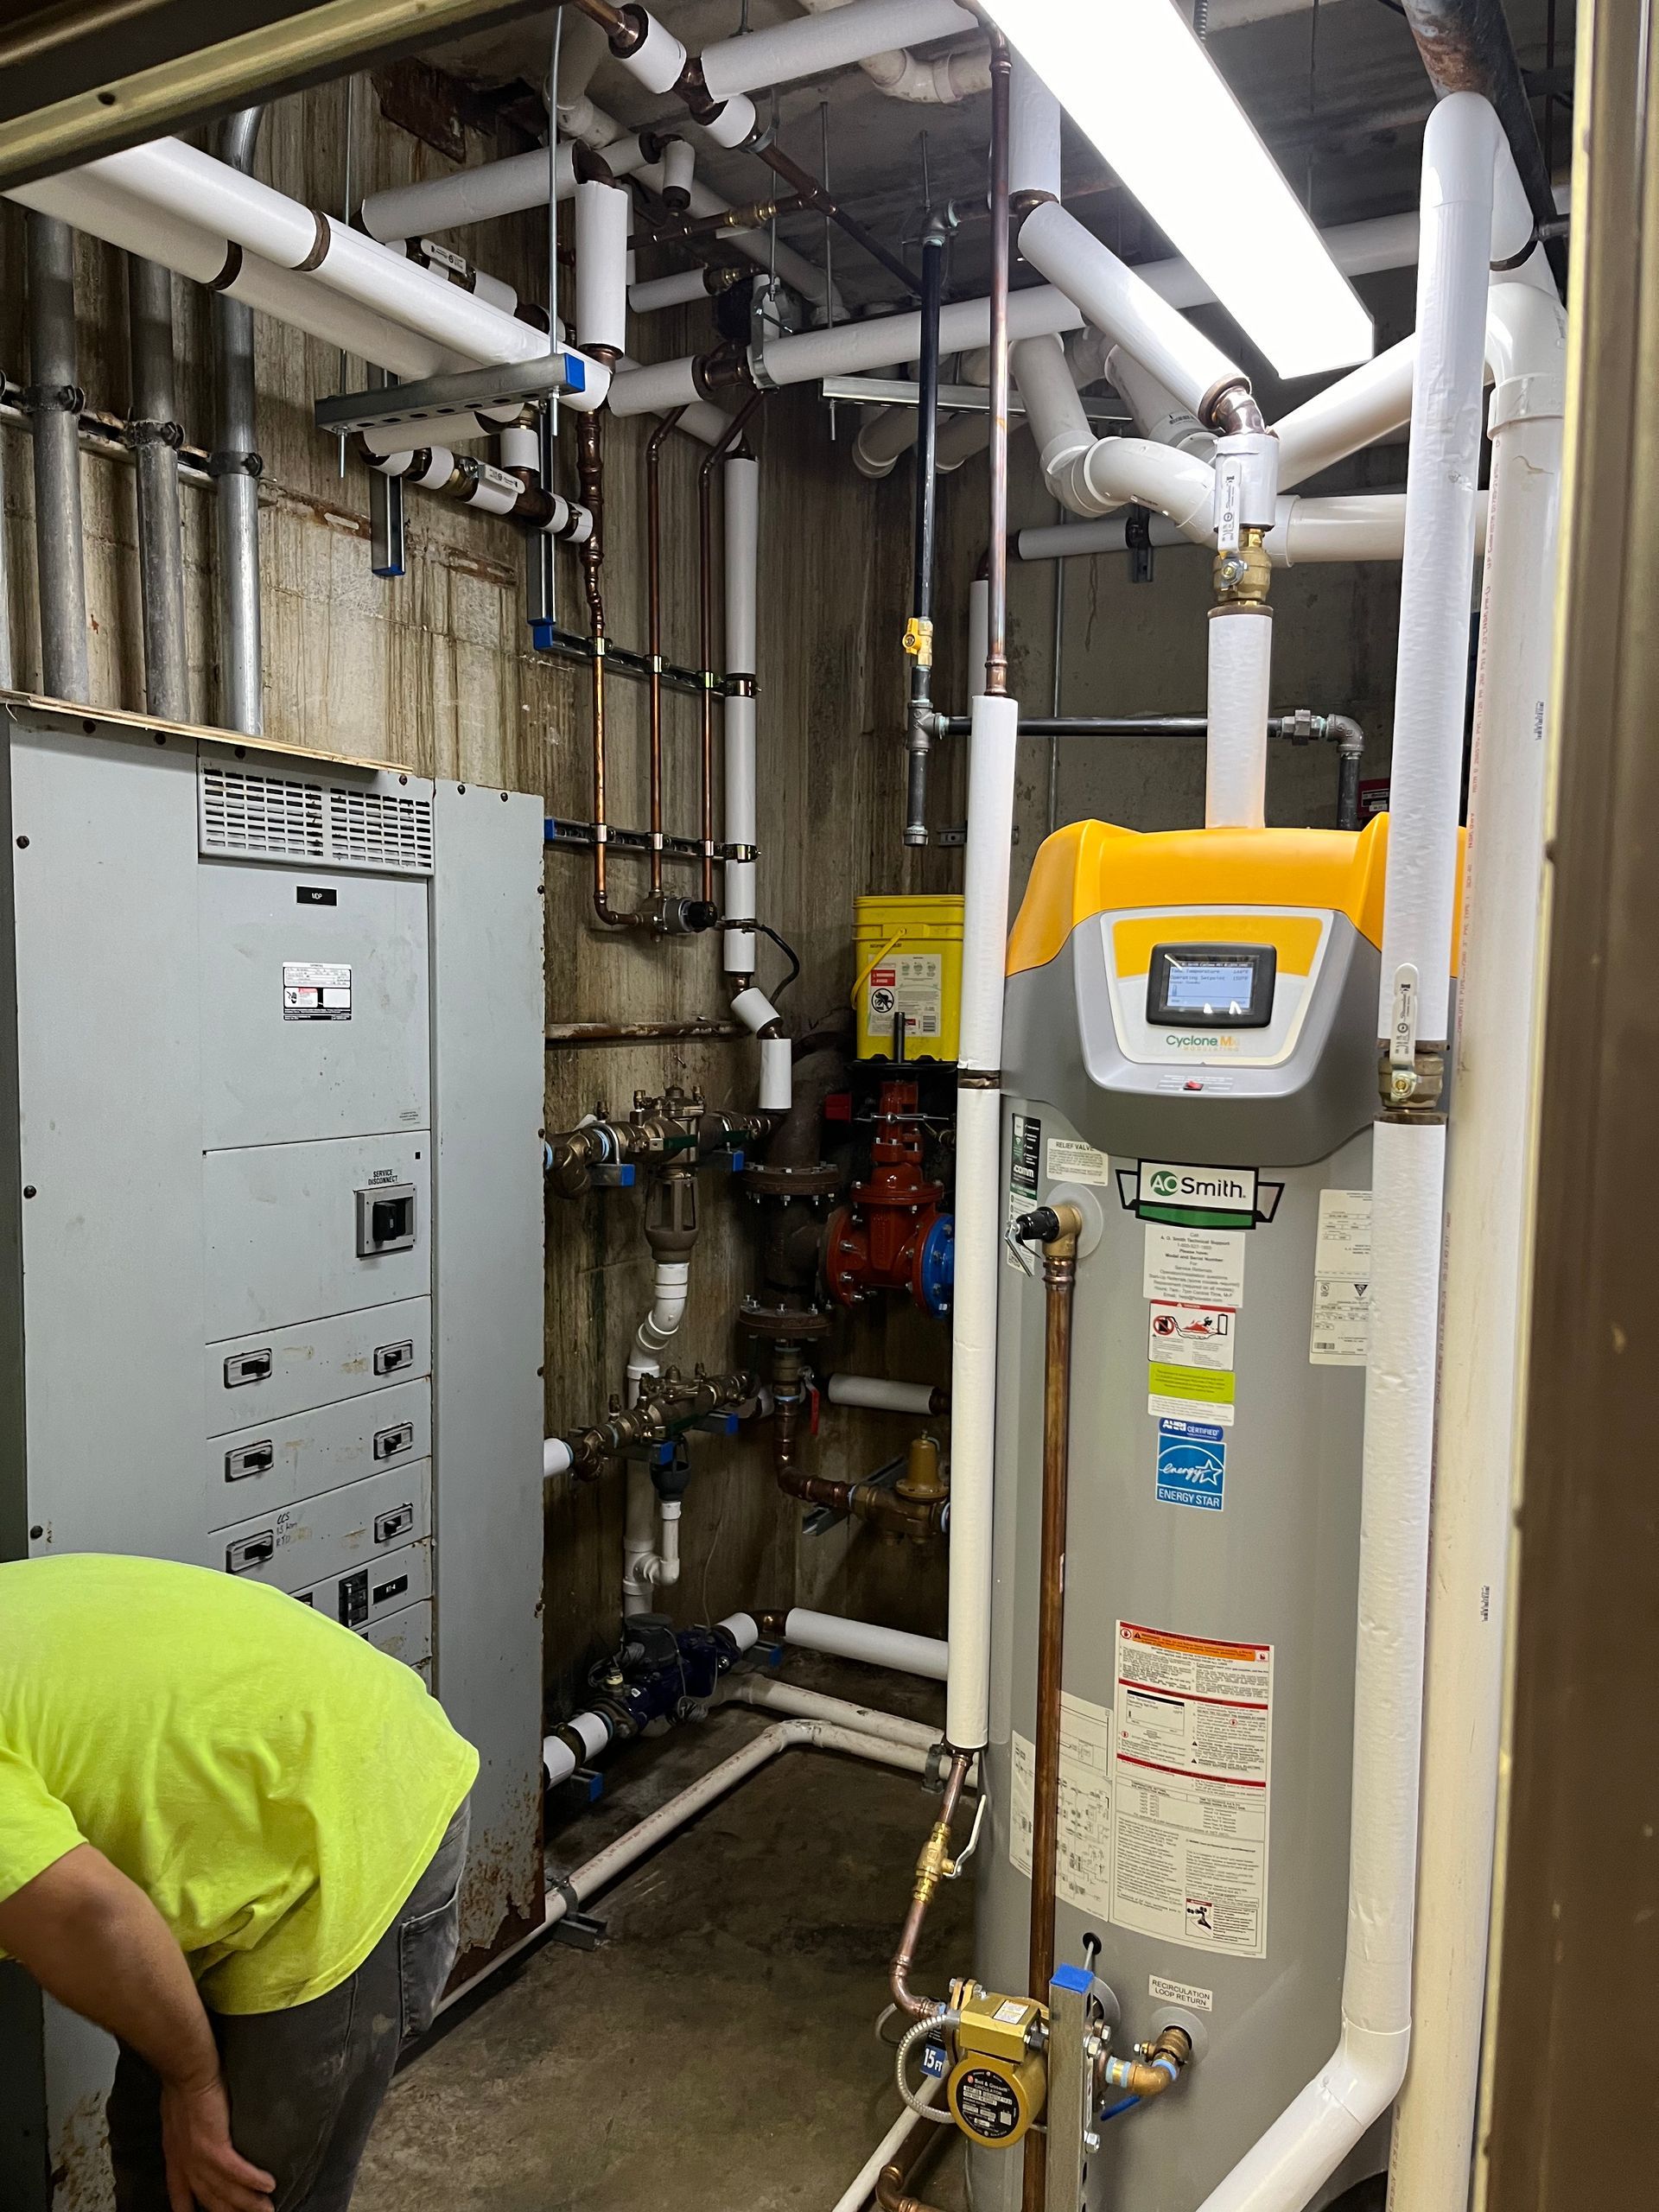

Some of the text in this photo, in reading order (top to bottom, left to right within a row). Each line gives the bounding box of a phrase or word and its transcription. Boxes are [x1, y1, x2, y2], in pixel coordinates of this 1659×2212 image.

[1166, 1034, 1218, 1047] Cyclone
[1075, 1142, 1094, 1151] VALV
[368, 1175, 397, 1185] DISCONNECT
[373, 1169, 392, 1178] SERVICE
[1151, 1174, 1243, 1198] AO Smith
[1187, 1426, 1217, 1436] CERTIFIED
[1163, 1463, 1203, 1483] energy
[1159, 1488, 1220, 1507] ENERGY STAR
[1152, 1980, 1210, 1999] RECIRCULATION
[1154, 1987, 1206, 2005] LOOP RETURN
[924, 2048, 943, 2072] 15 FT
